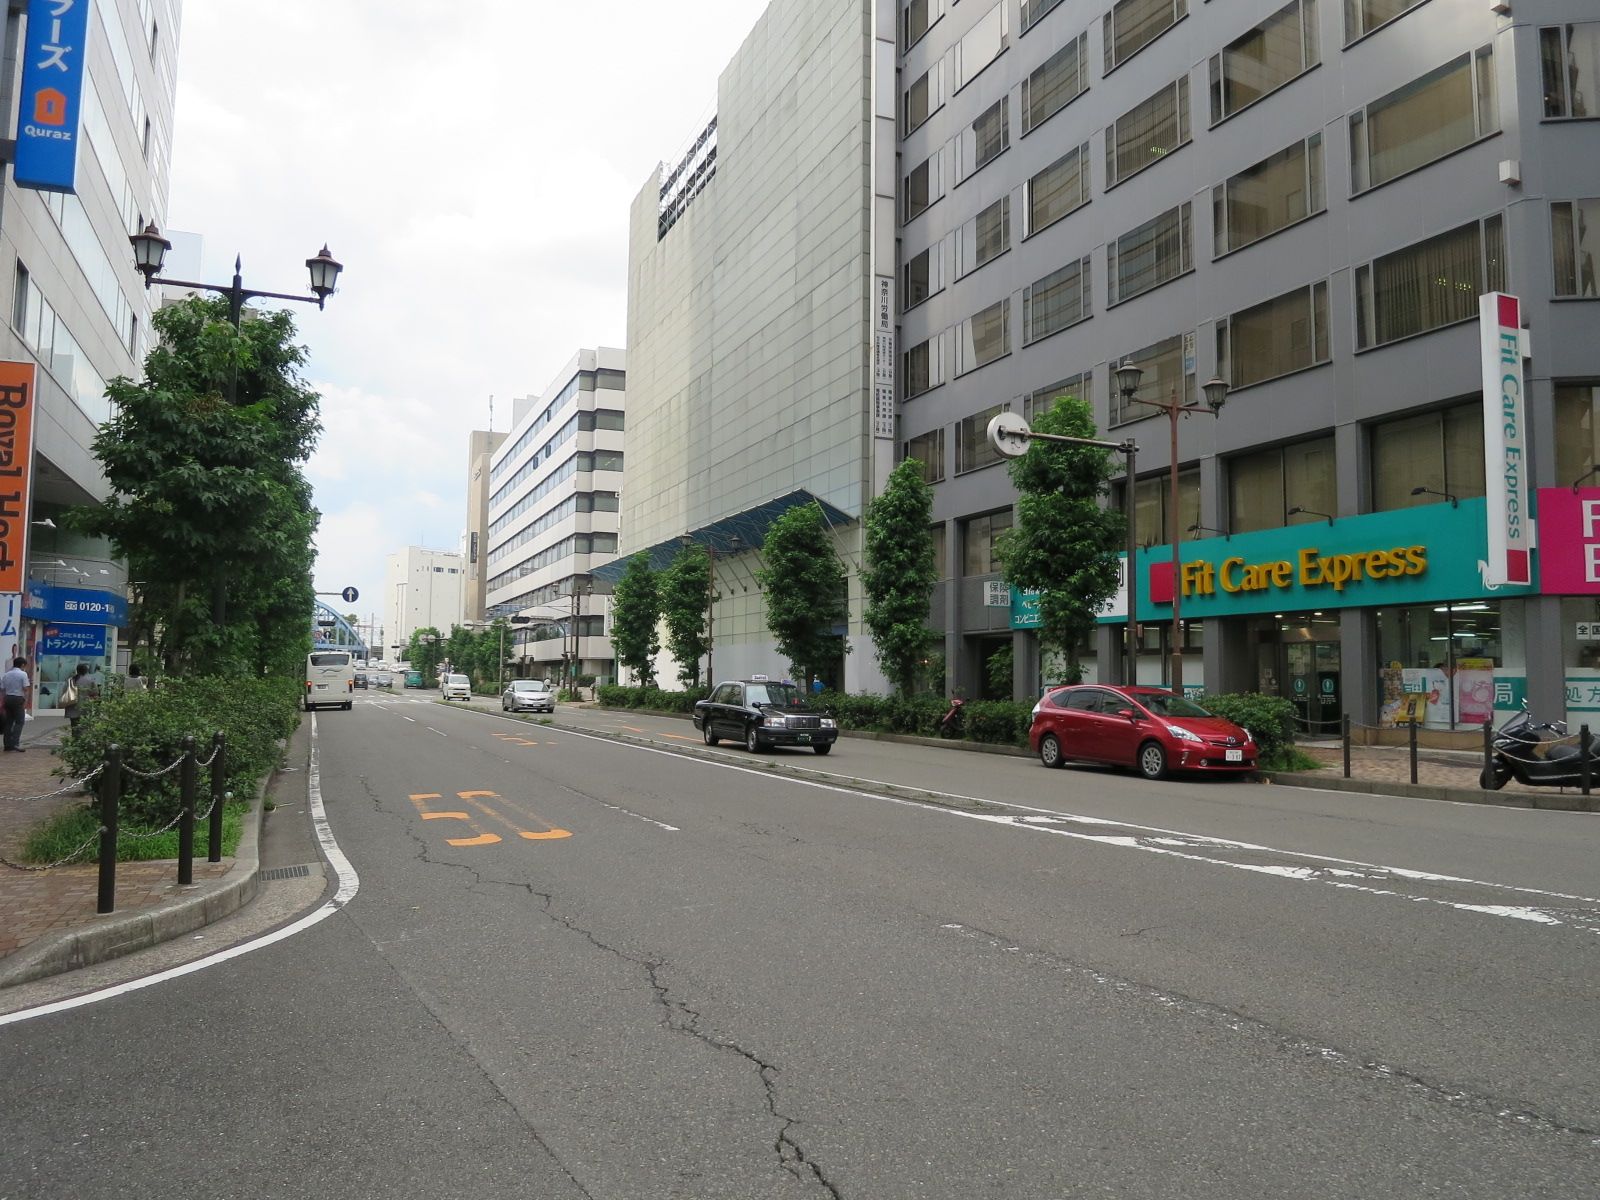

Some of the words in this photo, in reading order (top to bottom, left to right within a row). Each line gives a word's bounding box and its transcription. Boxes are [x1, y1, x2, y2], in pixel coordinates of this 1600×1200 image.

[24, 125, 72, 140] Quraz
[880, 280, 889, 328] 神奈川労働局
[1500, 332, 1519, 366] Fit
[1501, 374, 1519, 439] Care
[1505, 447, 1521, 539] Express
[1181, 559, 1215, 596] Fit
[1219, 557, 1293, 593] Care
[1298, 545, 1428, 591] Express
[0, 593, 17, 636] ーム
[989, 594, 1009, 605] 調剤
[1014, 614, 1041, 624] コンビニエ
[46, 639, 103, 649] トランクルーム
[1493, 682, 1513, 705] 局
[408, 790, 574, 846] 50
